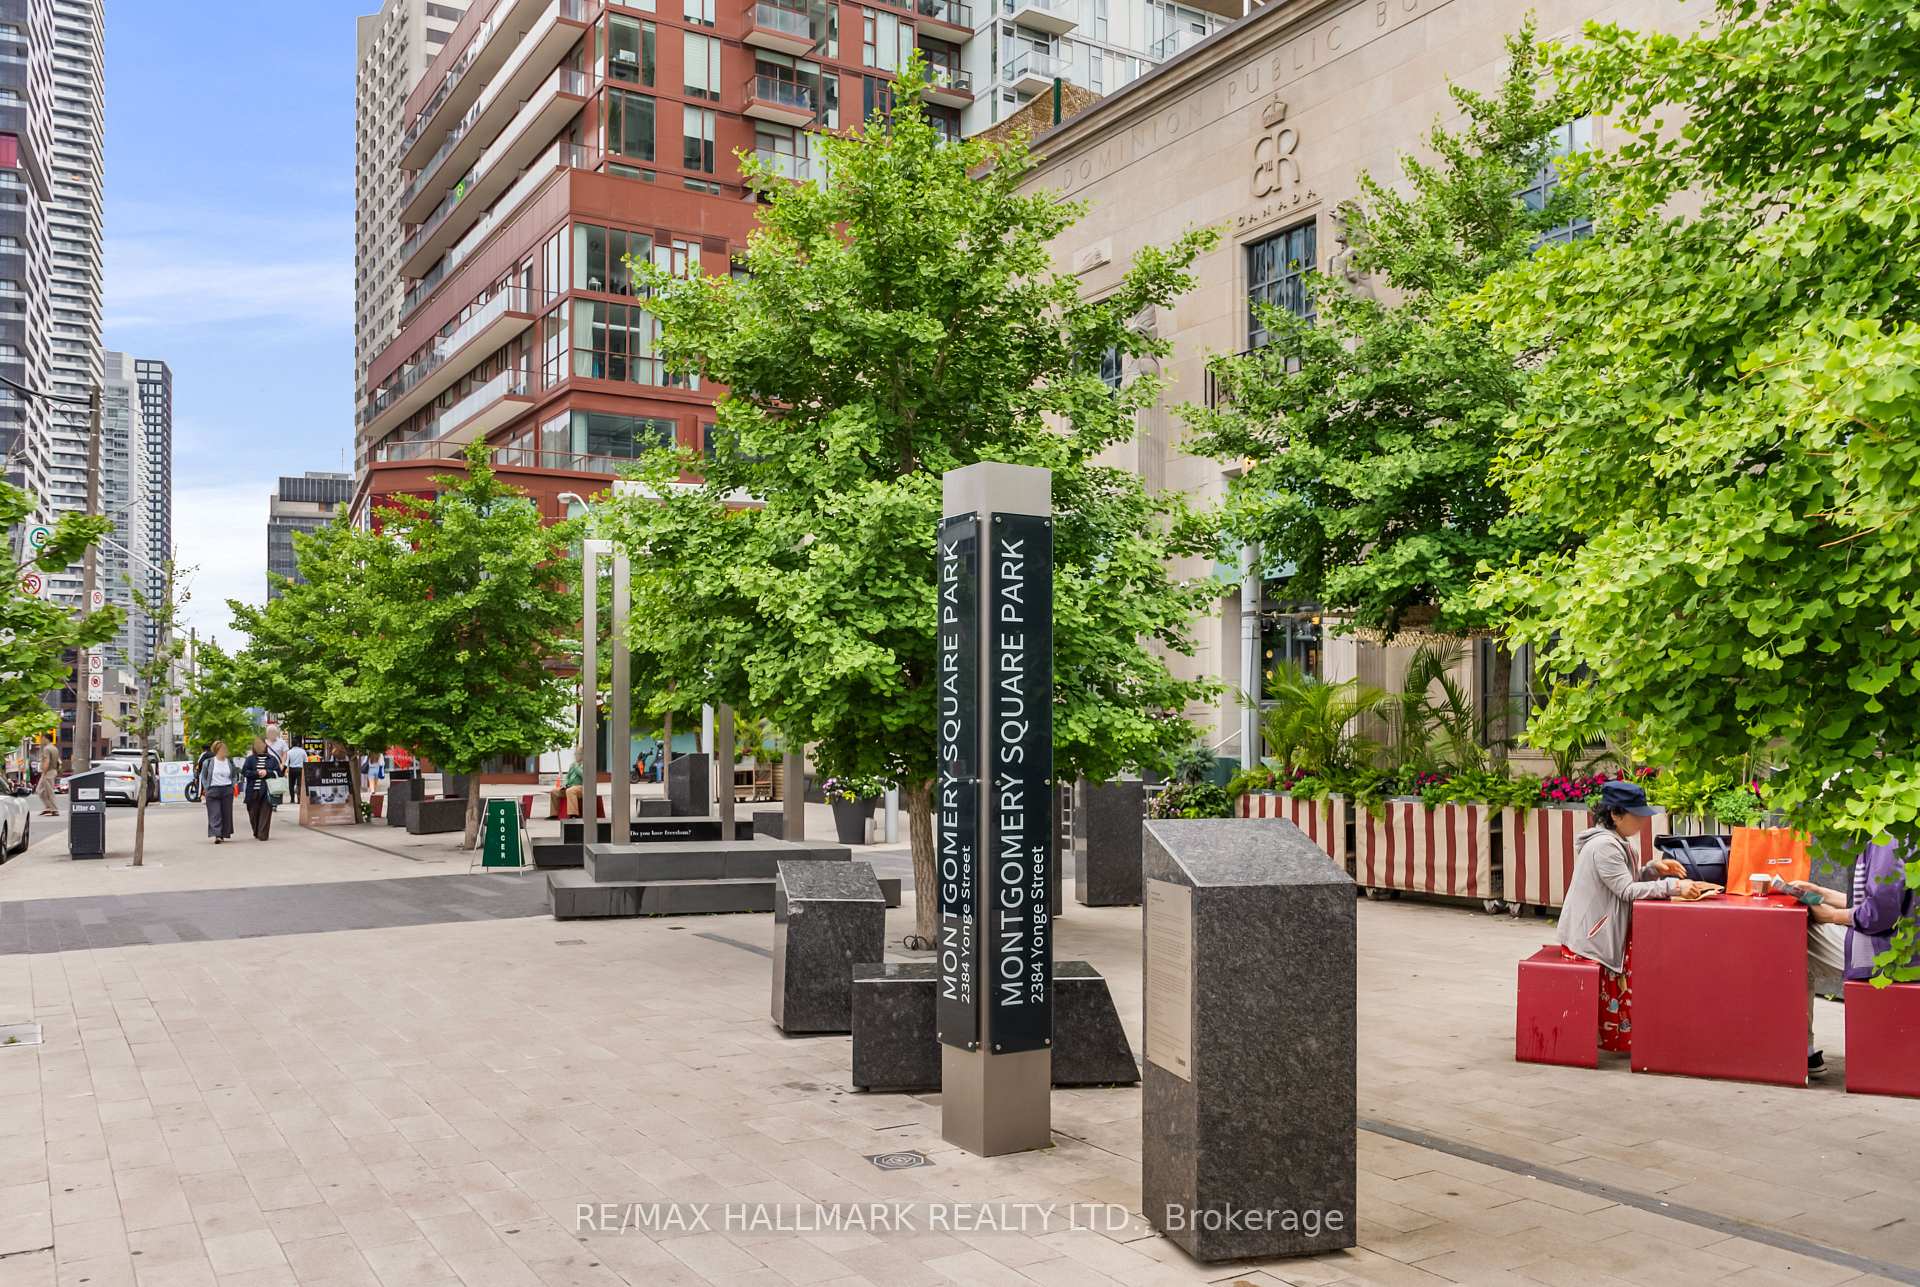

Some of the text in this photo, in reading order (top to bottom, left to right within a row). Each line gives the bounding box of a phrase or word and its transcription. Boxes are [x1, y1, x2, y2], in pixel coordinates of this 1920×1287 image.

[1063, 98, 1204, 190] DOMINION
[1227, 25, 1344, 105] PUBLIC
[1237, 188, 1317, 228] CANADA
[943, 539, 961, 1001] MONTGOMERY SQUARE PARK
[1000, 539, 1029, 1007] MONTGOMERY SQUARE PARK
[961, 845, 973, 1004] 2384 Yonge Street
[1031, 845, 1047, 1004] 2384 Yonge Street
